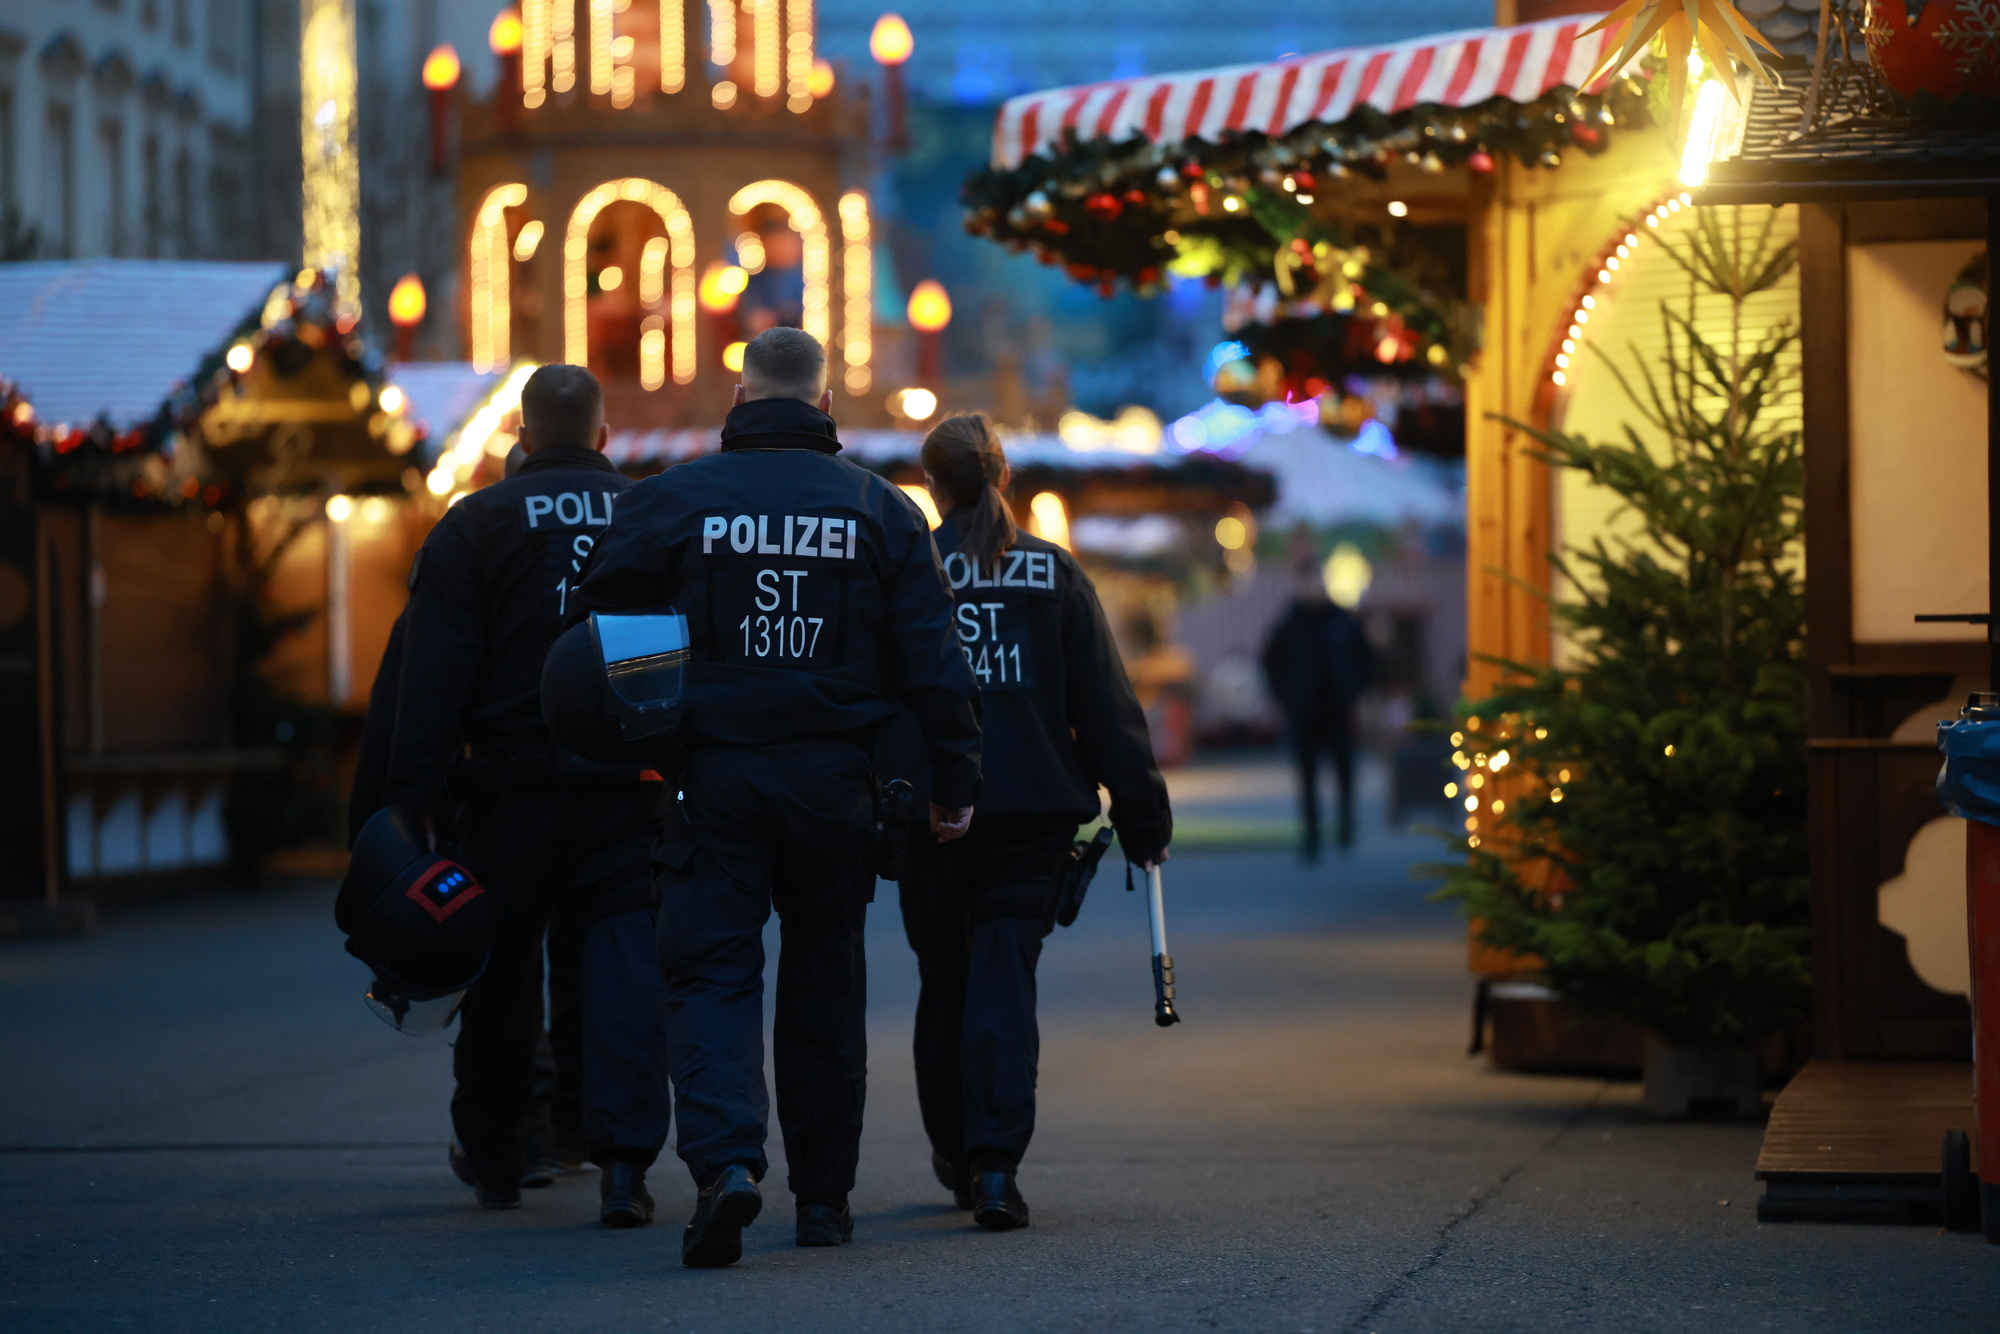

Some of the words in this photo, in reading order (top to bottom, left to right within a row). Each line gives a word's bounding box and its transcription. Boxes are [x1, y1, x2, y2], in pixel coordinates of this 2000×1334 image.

[525, 491, 618, 528] POLI
[703, 515, 857, 560] POLIZEI
[556, 577, 580, 615] 1
[755, 569, 808, 612] ST
[739, 614, 824, 658] 13107
[957, 603, 1004, 642] ST
